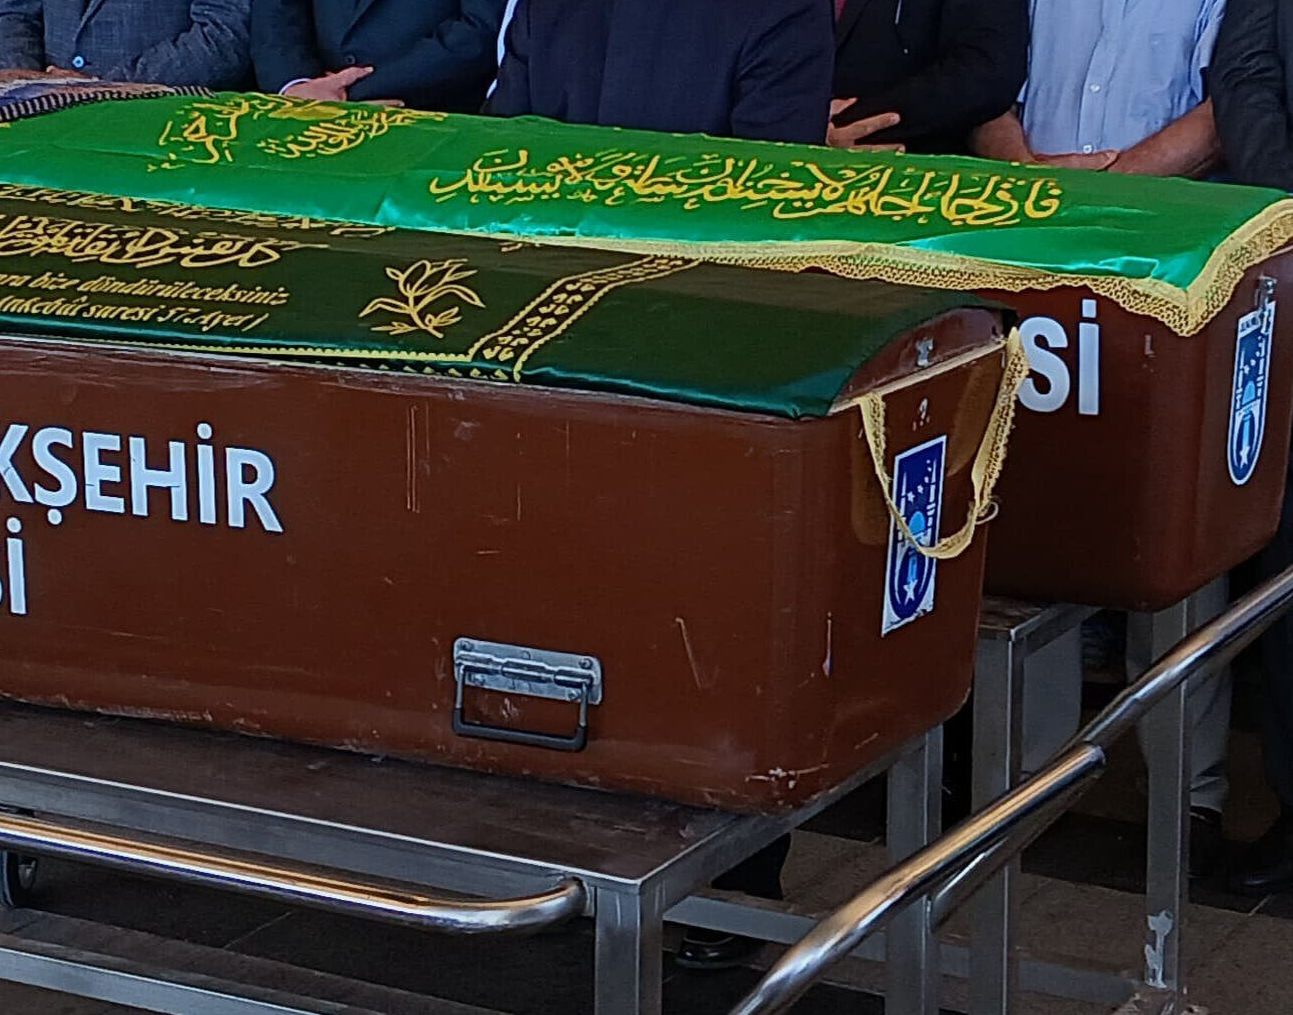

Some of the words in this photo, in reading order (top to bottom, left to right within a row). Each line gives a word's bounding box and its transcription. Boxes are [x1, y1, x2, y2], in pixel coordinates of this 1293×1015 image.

[28, 272, 79, 290] bize
[76, 275, 290, 306] döndürüleceksiniz
[85, 303, 166, 323] suresi
